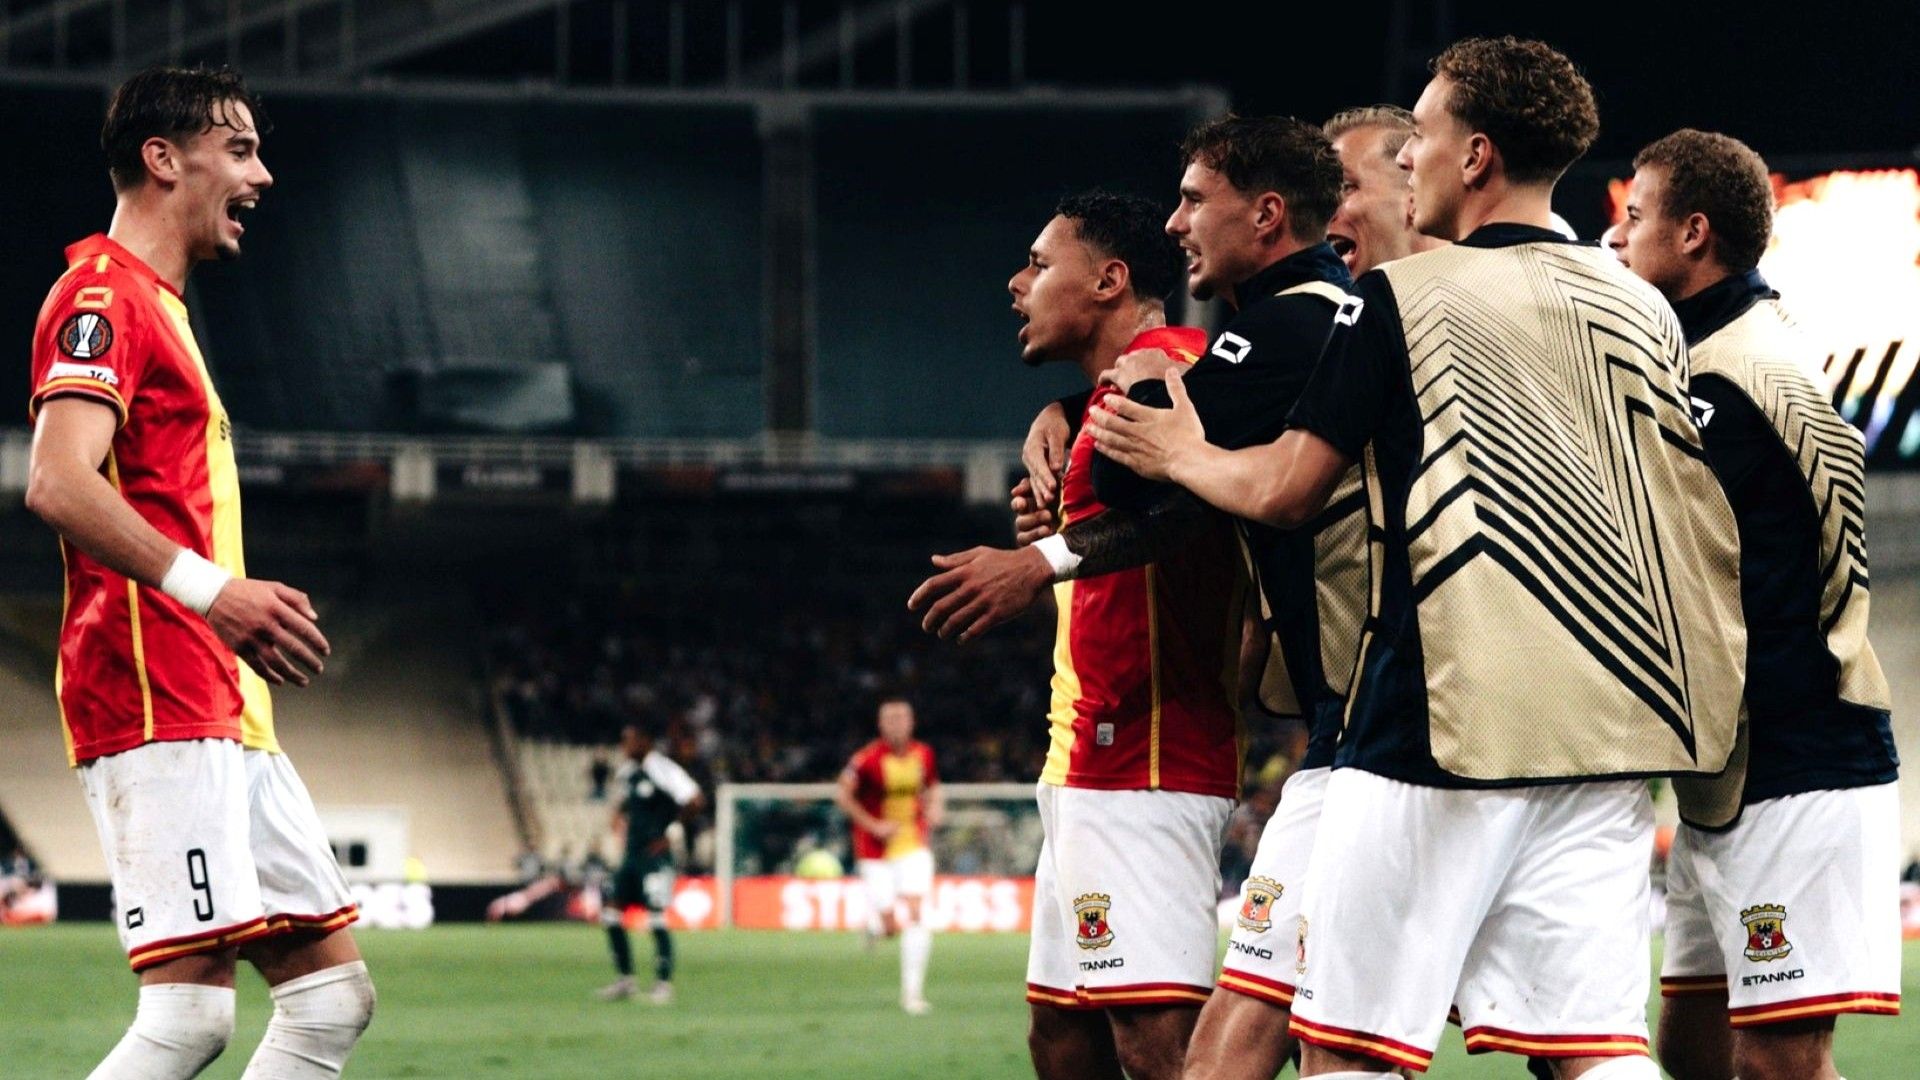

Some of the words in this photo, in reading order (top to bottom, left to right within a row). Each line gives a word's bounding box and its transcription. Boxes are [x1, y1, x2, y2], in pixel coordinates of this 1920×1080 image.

[186, 848, 214, 922] 9
[1078, 957, 1125, 971] TANNO
[1742, 969, 1804, 986] STANNO
